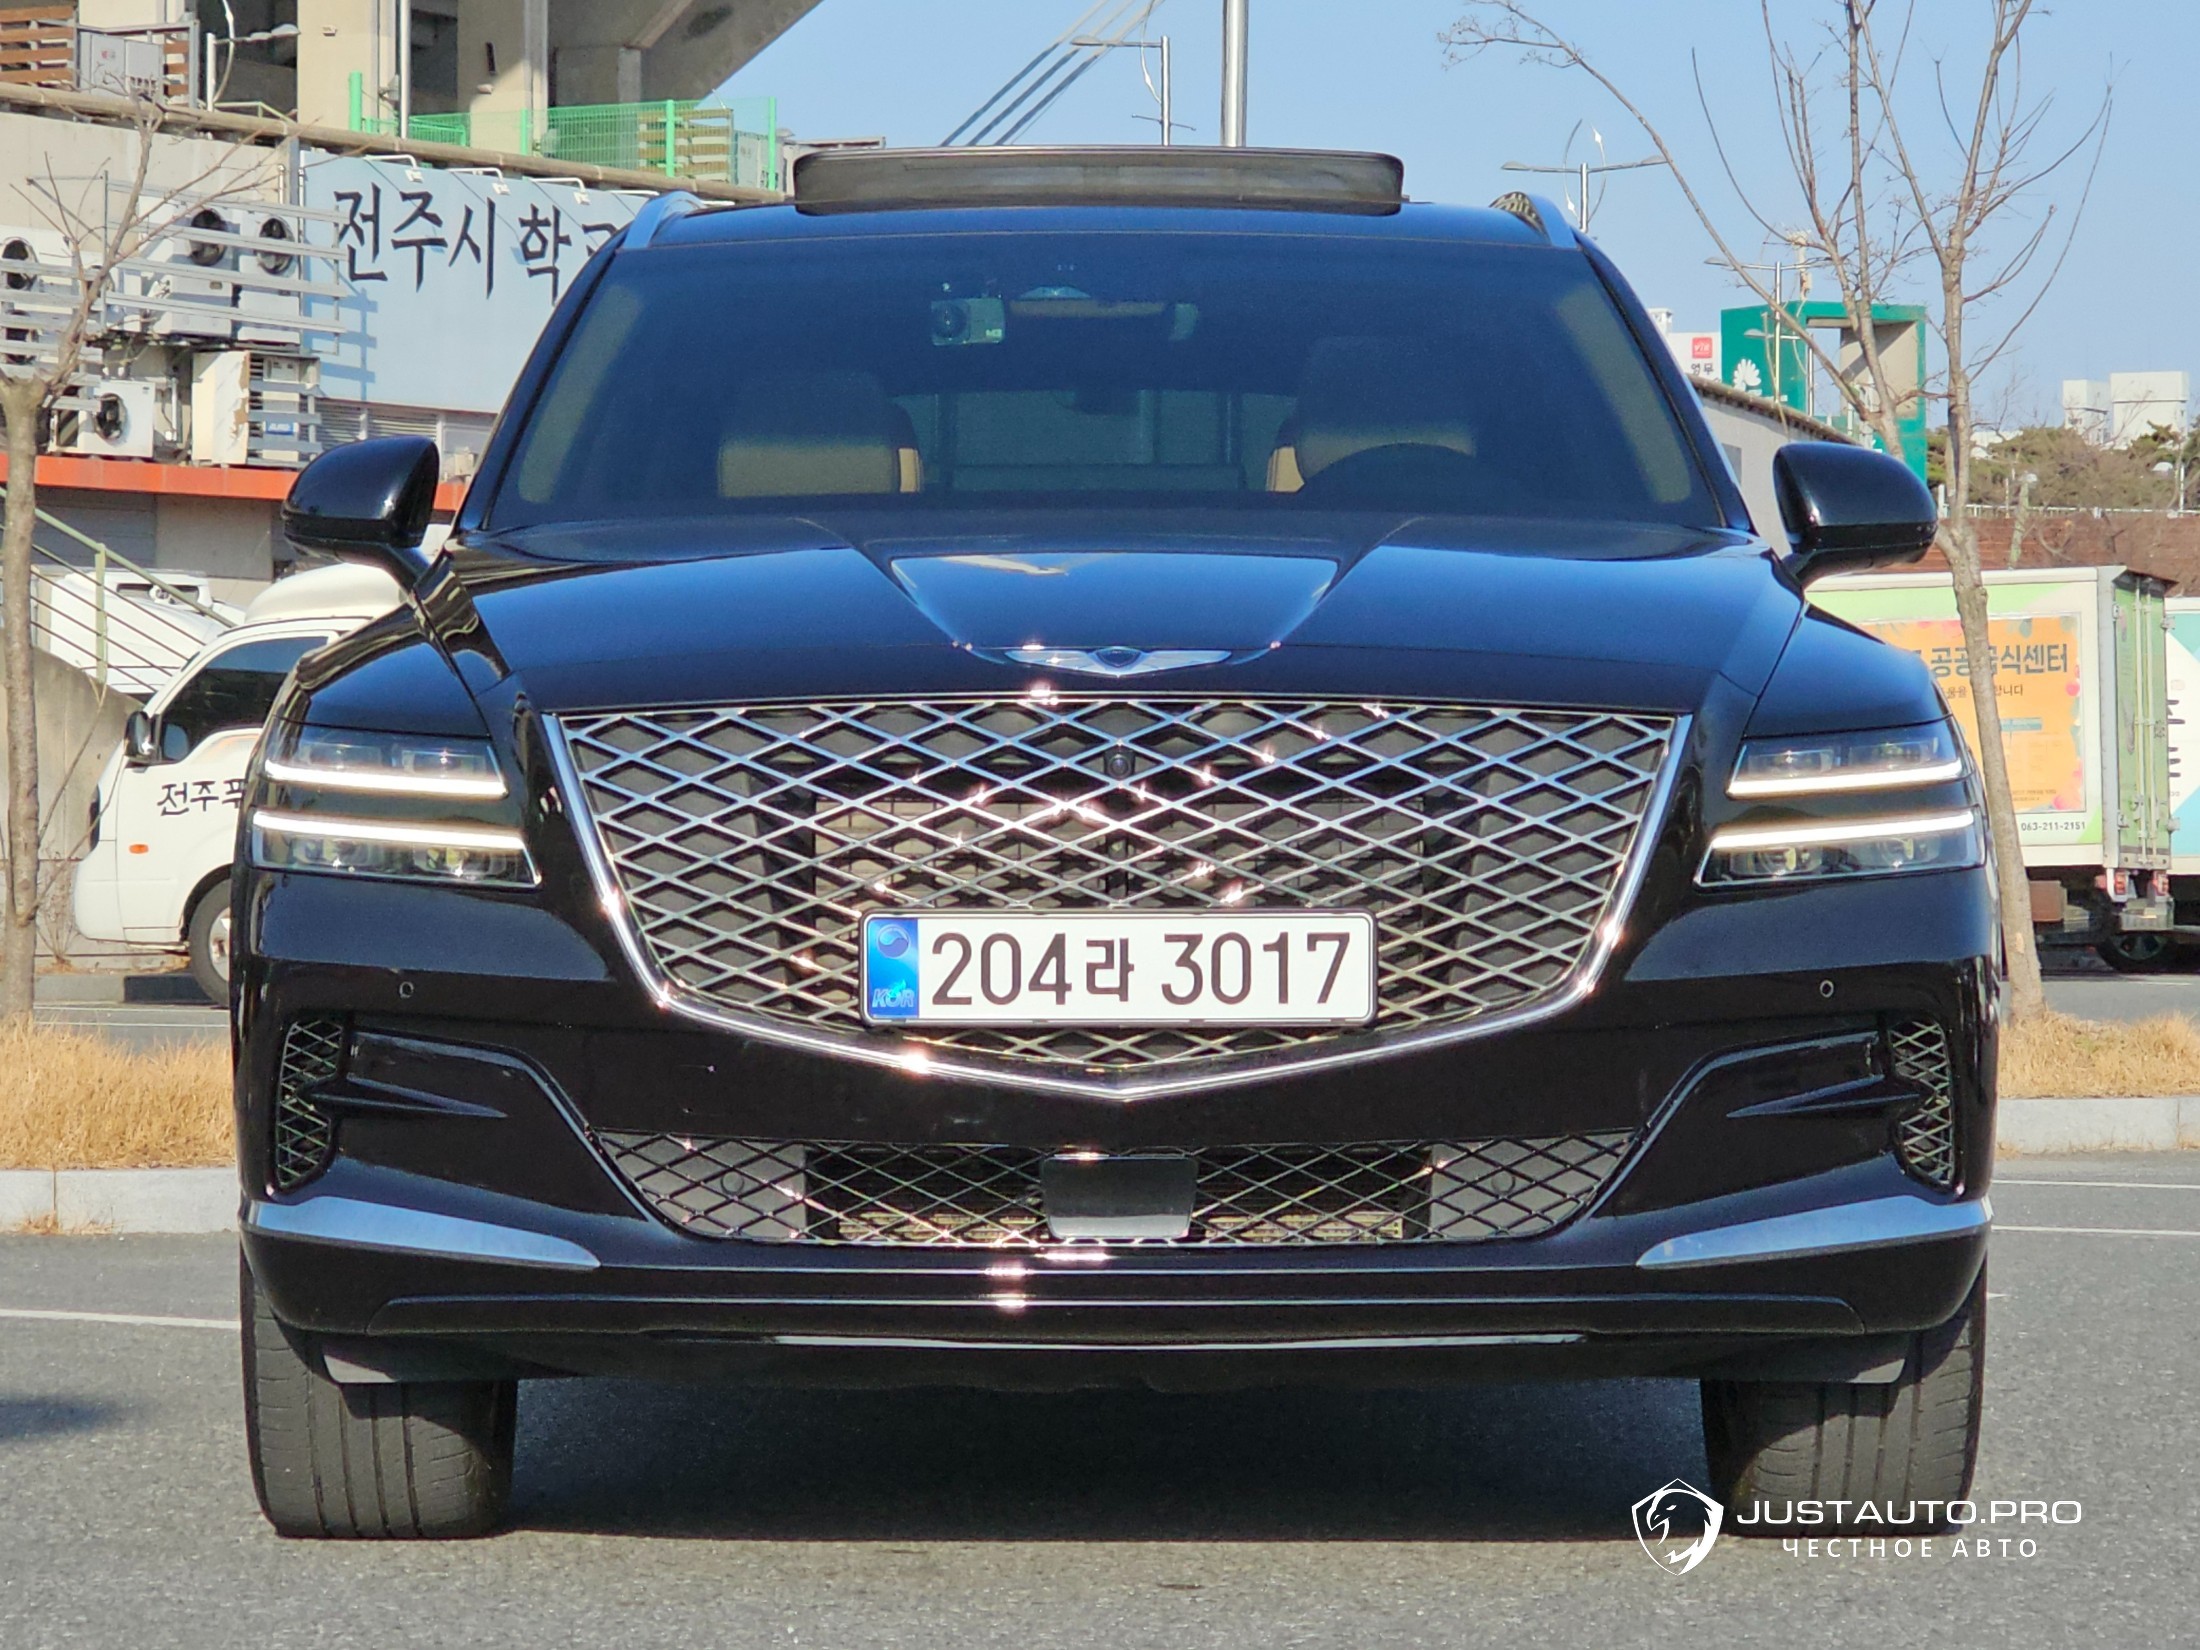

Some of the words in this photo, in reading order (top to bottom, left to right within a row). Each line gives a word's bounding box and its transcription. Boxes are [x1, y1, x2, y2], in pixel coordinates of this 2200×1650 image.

[334, 182, 496, 300] 전주시
[2021, 821, 2086, 832] 063-211-2151
[932, 932, 1135, 1006] 204라
[1162, 932, 1351, 1006] 3017
[872, 988, 915, 1008] KOR
